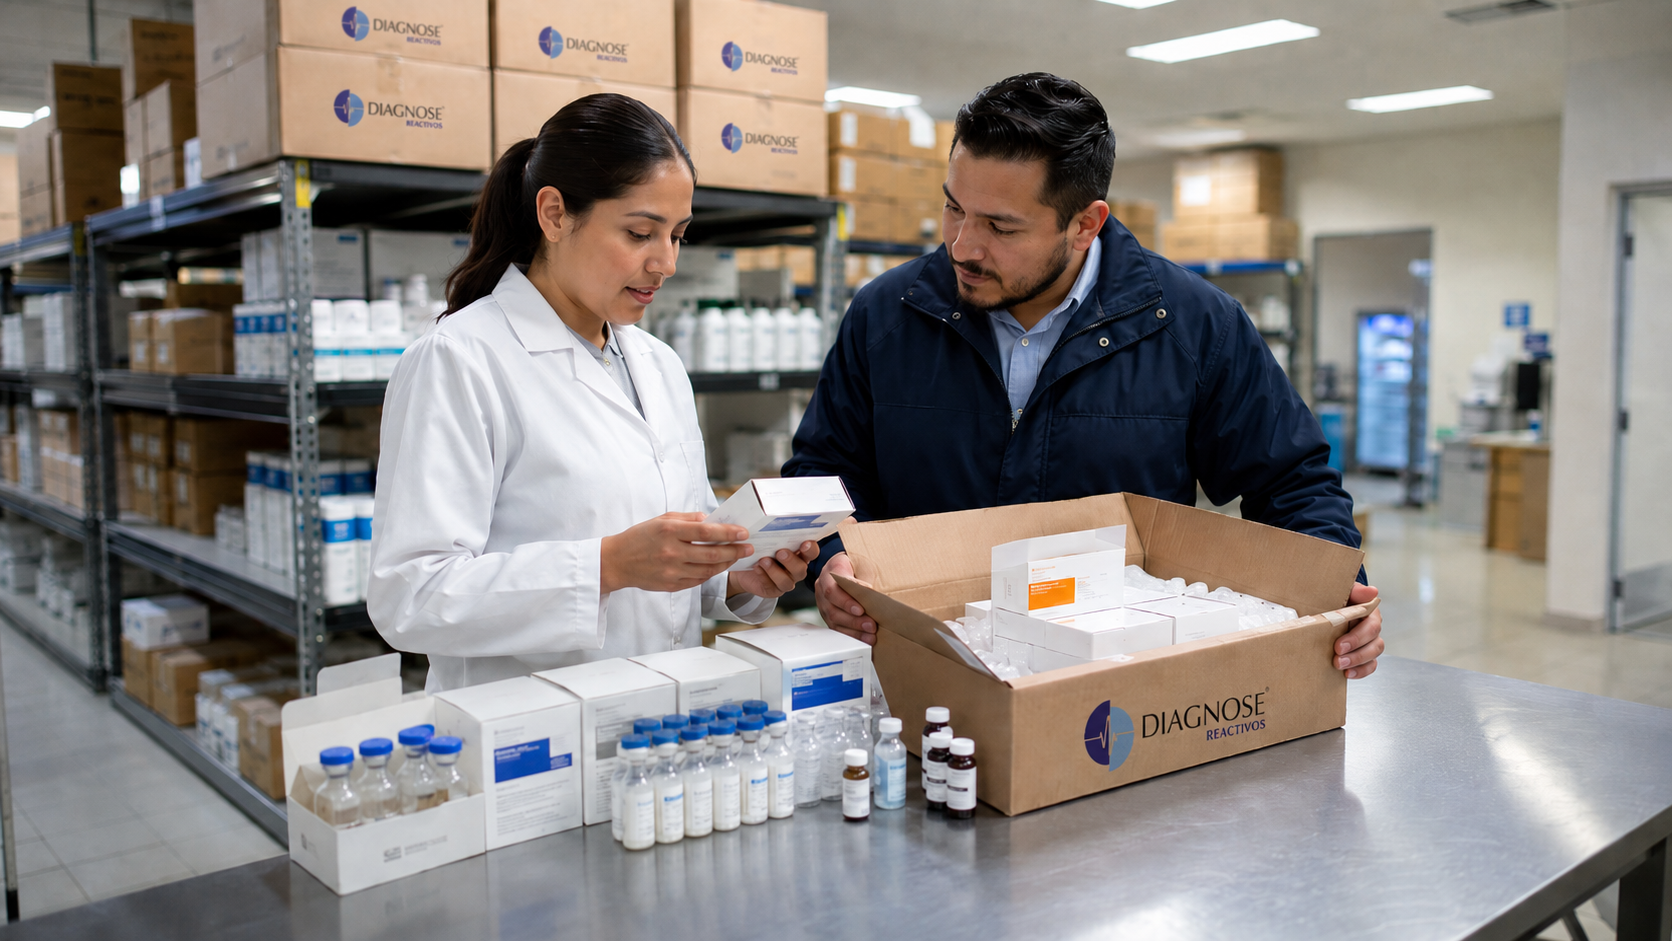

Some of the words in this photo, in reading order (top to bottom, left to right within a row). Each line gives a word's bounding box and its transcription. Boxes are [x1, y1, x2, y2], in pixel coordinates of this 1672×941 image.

[373, 18, 441, 38] DIAGNOSE
[566, 37, 627, 56] DIAGNOSE
[745, 51, 798, 68] DIAGNOSE
[368, 101, 443, 120] DIAGNOSE
[406, 120, 443, 129] REACTIVOS
[745, 132, 798, 148] DIAGNOSE
[1142, 691, 1265, 739] DIAGNOSE
[1206, 719, 1266, 741] REACTIVOS
